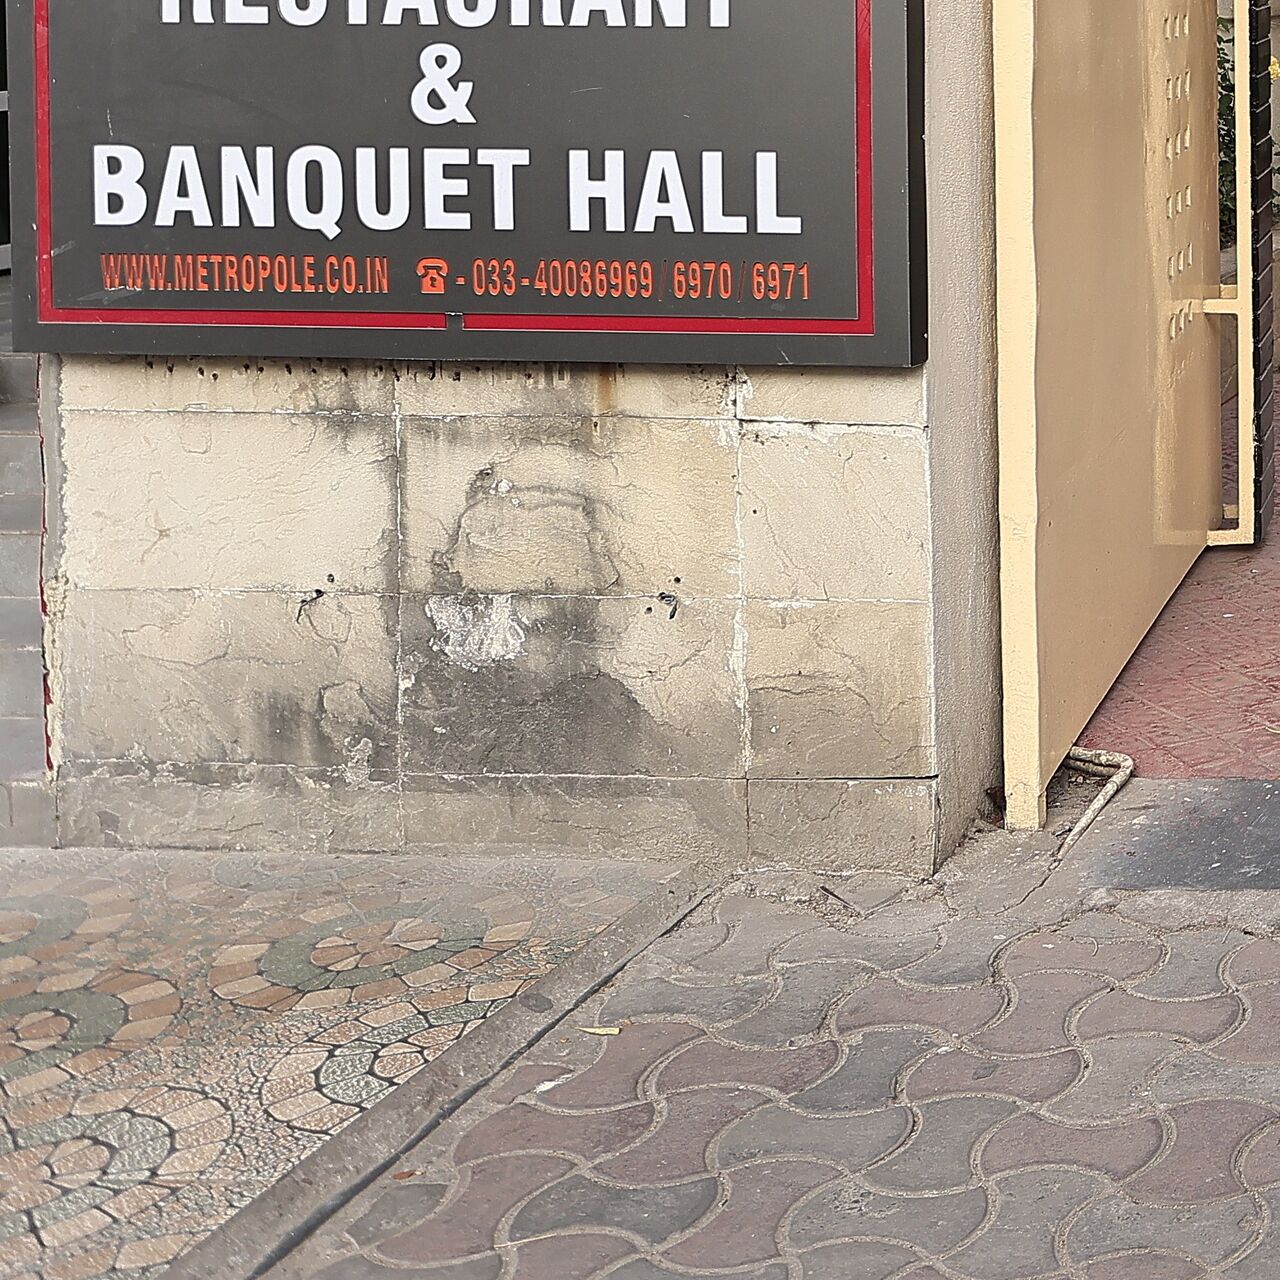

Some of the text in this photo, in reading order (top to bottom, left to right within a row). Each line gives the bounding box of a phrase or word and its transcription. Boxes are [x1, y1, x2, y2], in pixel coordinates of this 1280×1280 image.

[411, 43, 477, 125] &
[92, 144, 802, 239] BANQUET HALL
[100, 253, 390, 293] WWW.METROPOLE.CO.IN
